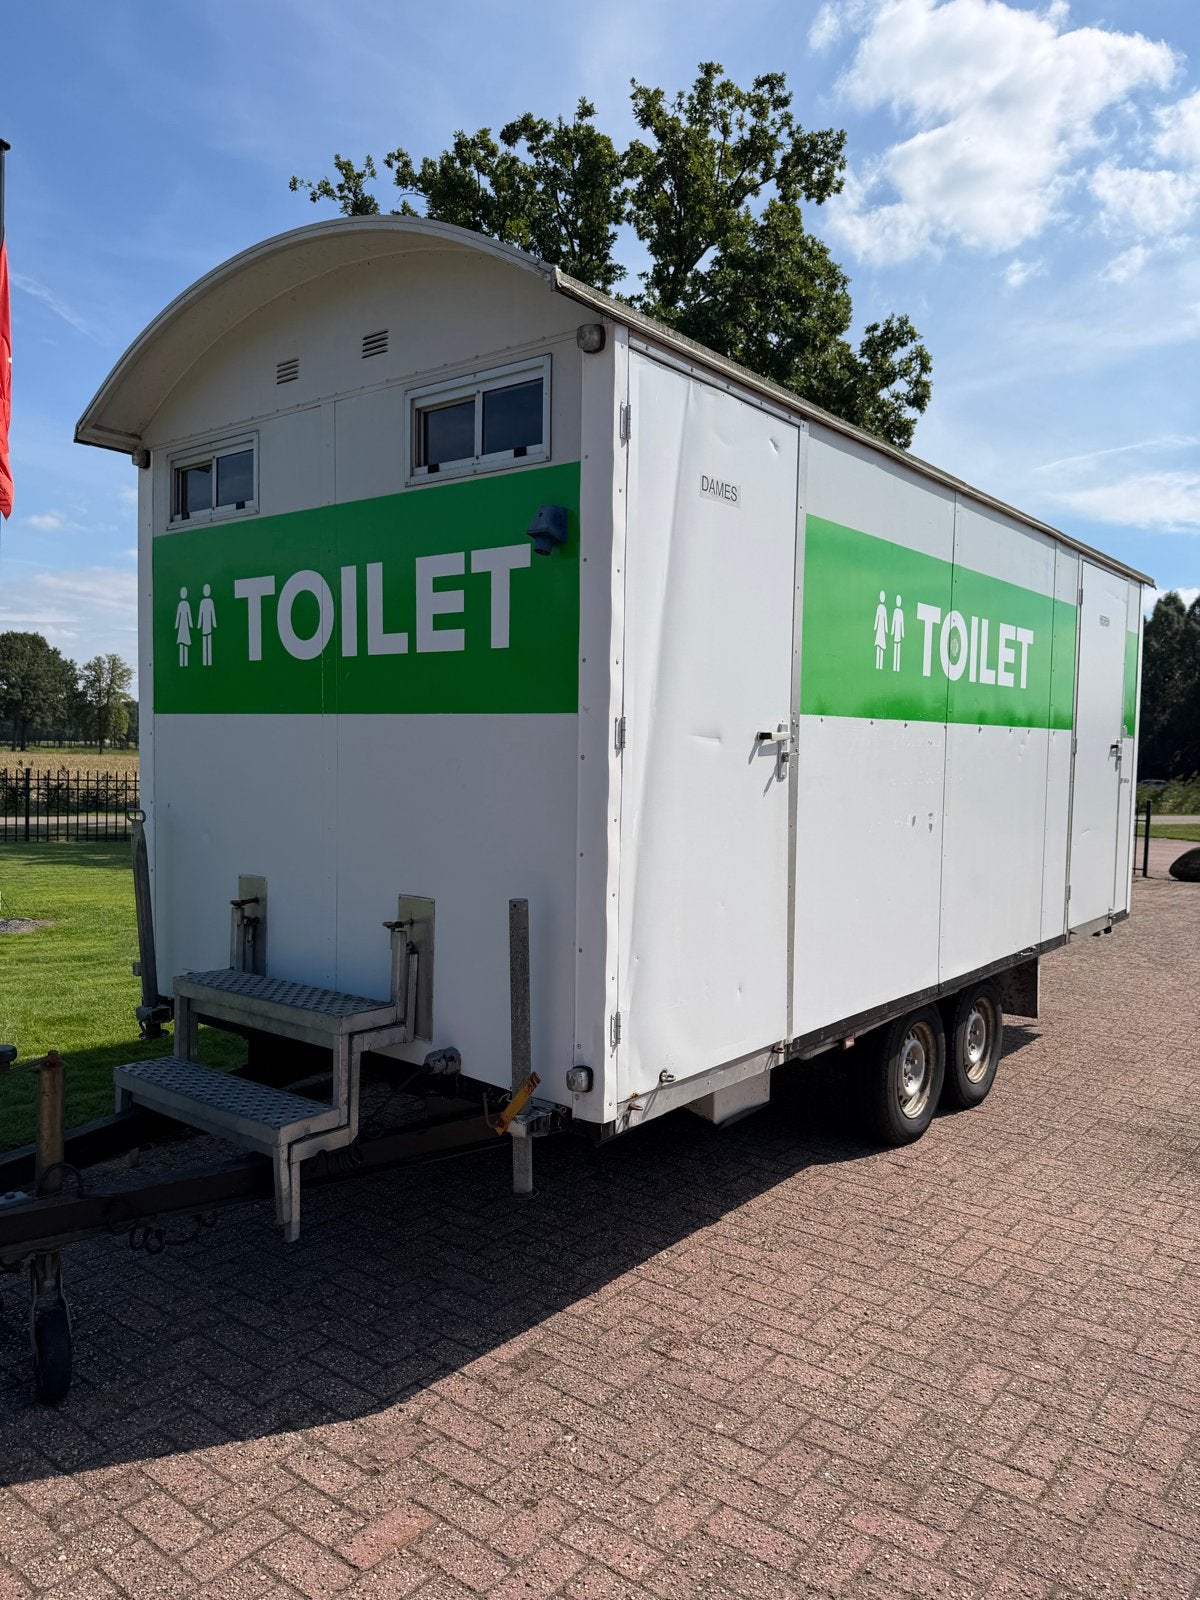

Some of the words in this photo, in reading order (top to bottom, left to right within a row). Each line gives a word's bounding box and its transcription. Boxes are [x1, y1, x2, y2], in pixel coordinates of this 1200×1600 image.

[701, 475, 738, 502] DAMES
[234, 543, 531, 661] TOILET
[917, 602, 1034, 689] TOILET
